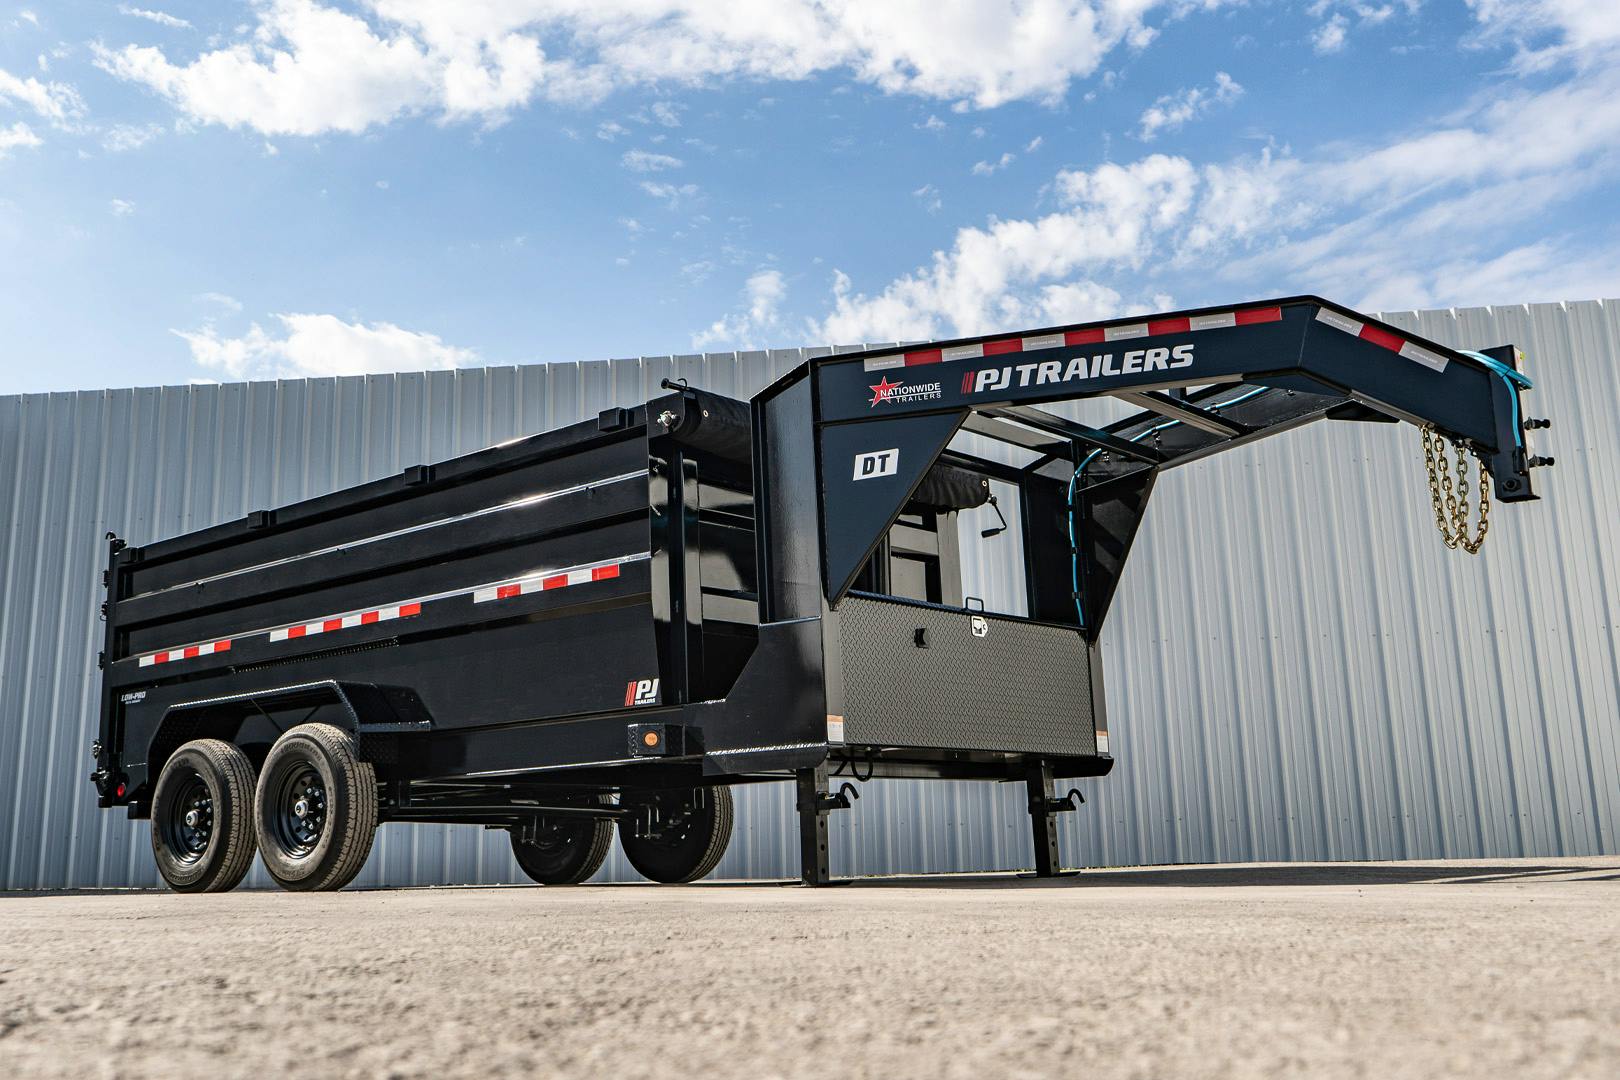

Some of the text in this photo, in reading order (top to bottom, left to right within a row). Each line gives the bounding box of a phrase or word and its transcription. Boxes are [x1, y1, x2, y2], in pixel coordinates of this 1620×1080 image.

[974, 344, 1195, 393] PJ TRAILERS
[880, 382, 941, 397] NATIONWIDE
[896, 393, 941, 403] TRAILERS
[862, 454, 890, 475] DT
[635, 678, 659, 699] PJ
